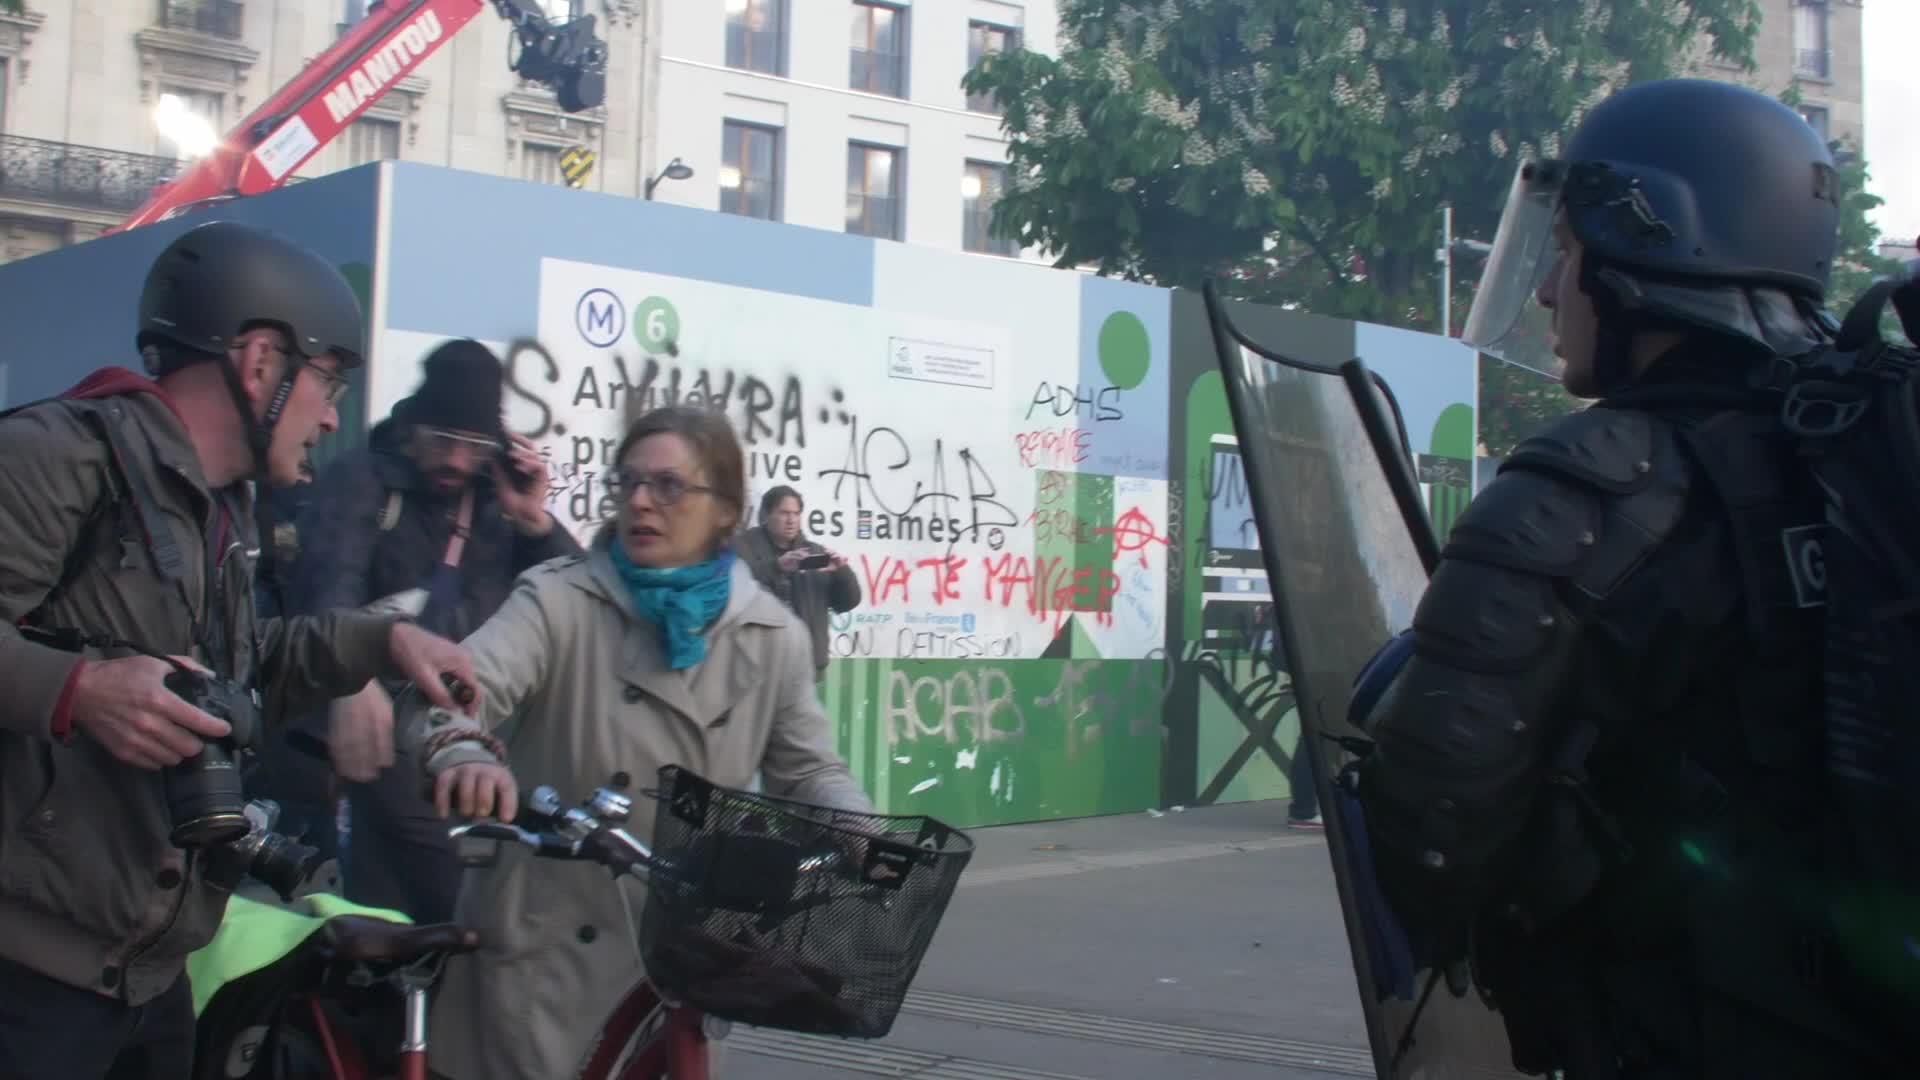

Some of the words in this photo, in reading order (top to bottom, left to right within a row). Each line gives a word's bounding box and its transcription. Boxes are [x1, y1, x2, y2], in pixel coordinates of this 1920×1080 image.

[322, 9, 444, 124] MANITOU
[1025, 381, 1122, 421] ADHS
[818, 414, 1018, 546] ACAB
[861, 553, 912, 608] VA
[916, 555, 969, 606] TE
[983, 552, 1121, 641] MANGER
[885, 667, 1025, 746] ACAB
